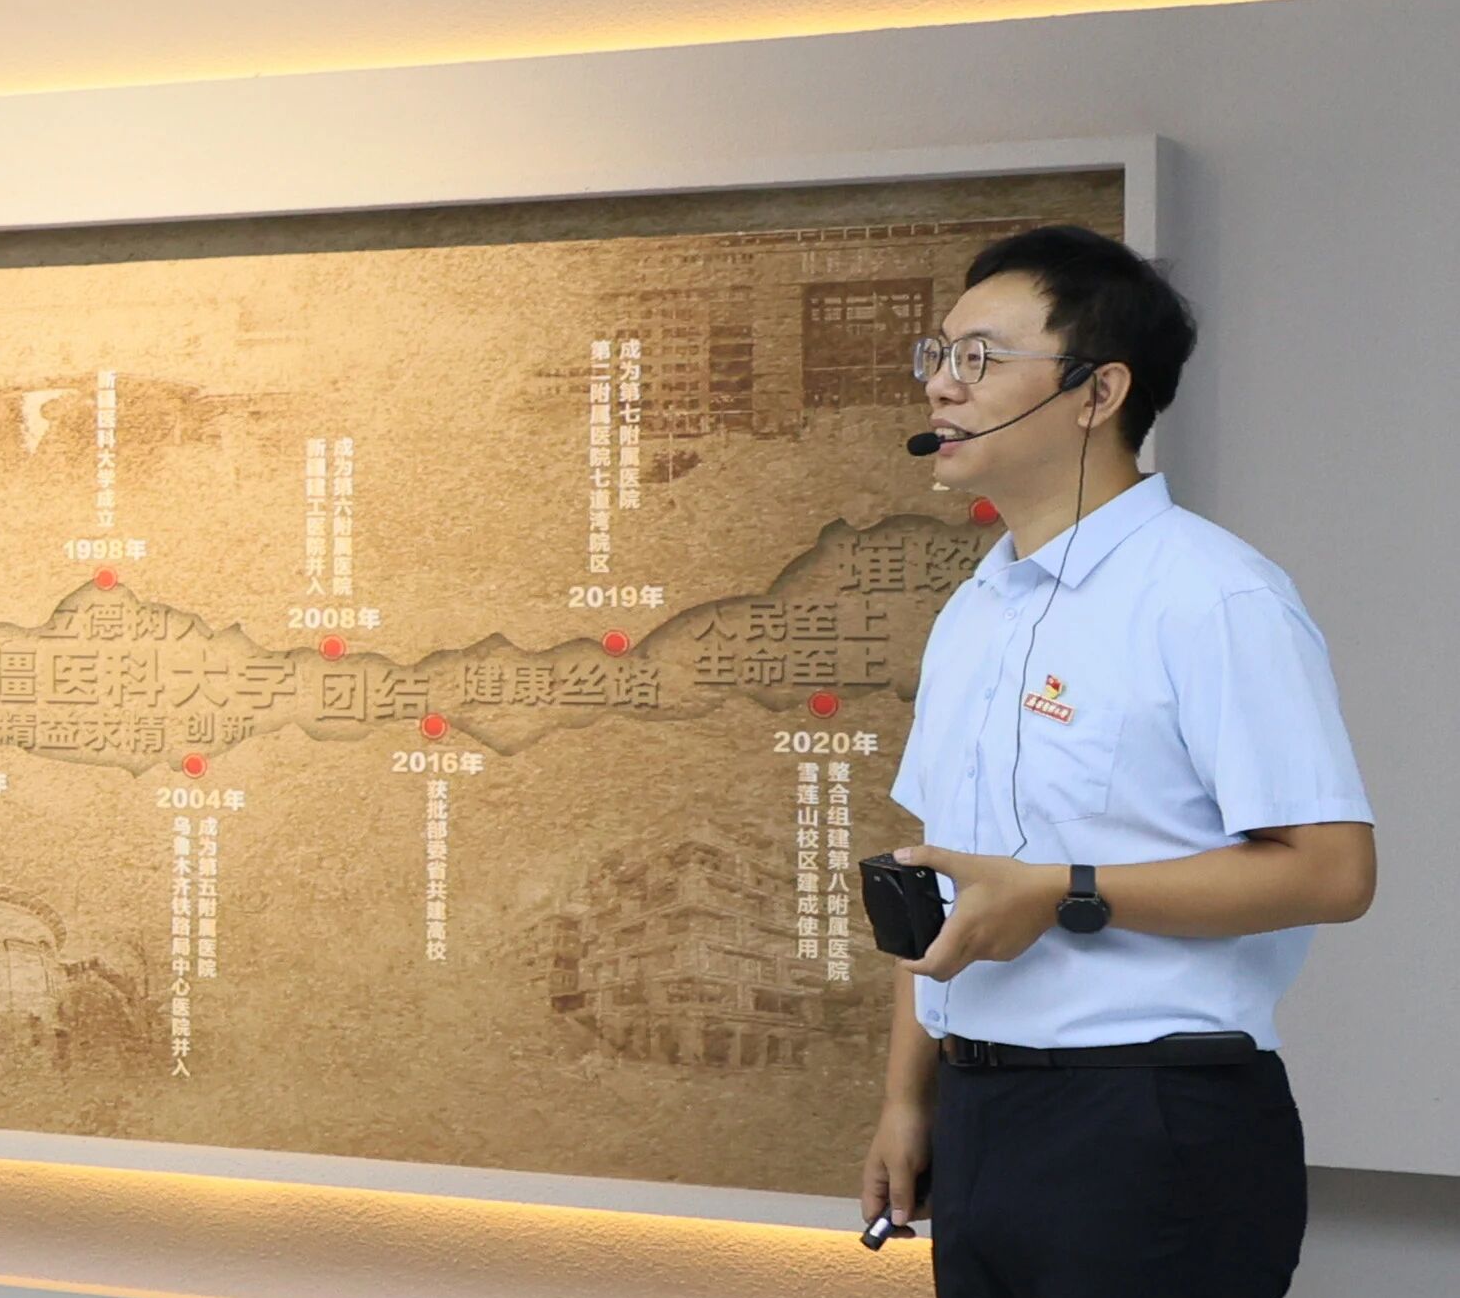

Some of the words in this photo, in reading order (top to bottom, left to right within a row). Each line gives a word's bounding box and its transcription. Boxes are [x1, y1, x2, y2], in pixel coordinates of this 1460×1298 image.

[619, 339, 641, 509] 成为第七附属医院
[96, 370, 117, 528] 新疆医科大学成立
[332, 437, 354, 596] 成为第六附属医院
[64, 539, 147, 561] 1998年
[568, 585, 665, 609] 2019年
[39, 603, 216, 642] 立德树人
[288, 607, 381, 630] 2008年
[694, 601, 891, 641] 人民至上
[460, 662, 661, 710] 健康丝路
[694, 646, 892, 687] 生命至上
[316, 669, 429, 722] 团结
[183, 711, 256, 745] 创新
[773, 731, 878, 755] 2020年
[391, 751, 486, 776] 2016年
[156, 788, 246, 811] 2004年
[426, 780, 449, 962] 获批部委省共建高校
[797, 762, 819, 959] 雪莲山校区建成使用
[827, 762, 850, 981] 整合组建第八附属医院
[197, 816, 218, 978] 成为第五附属医院
